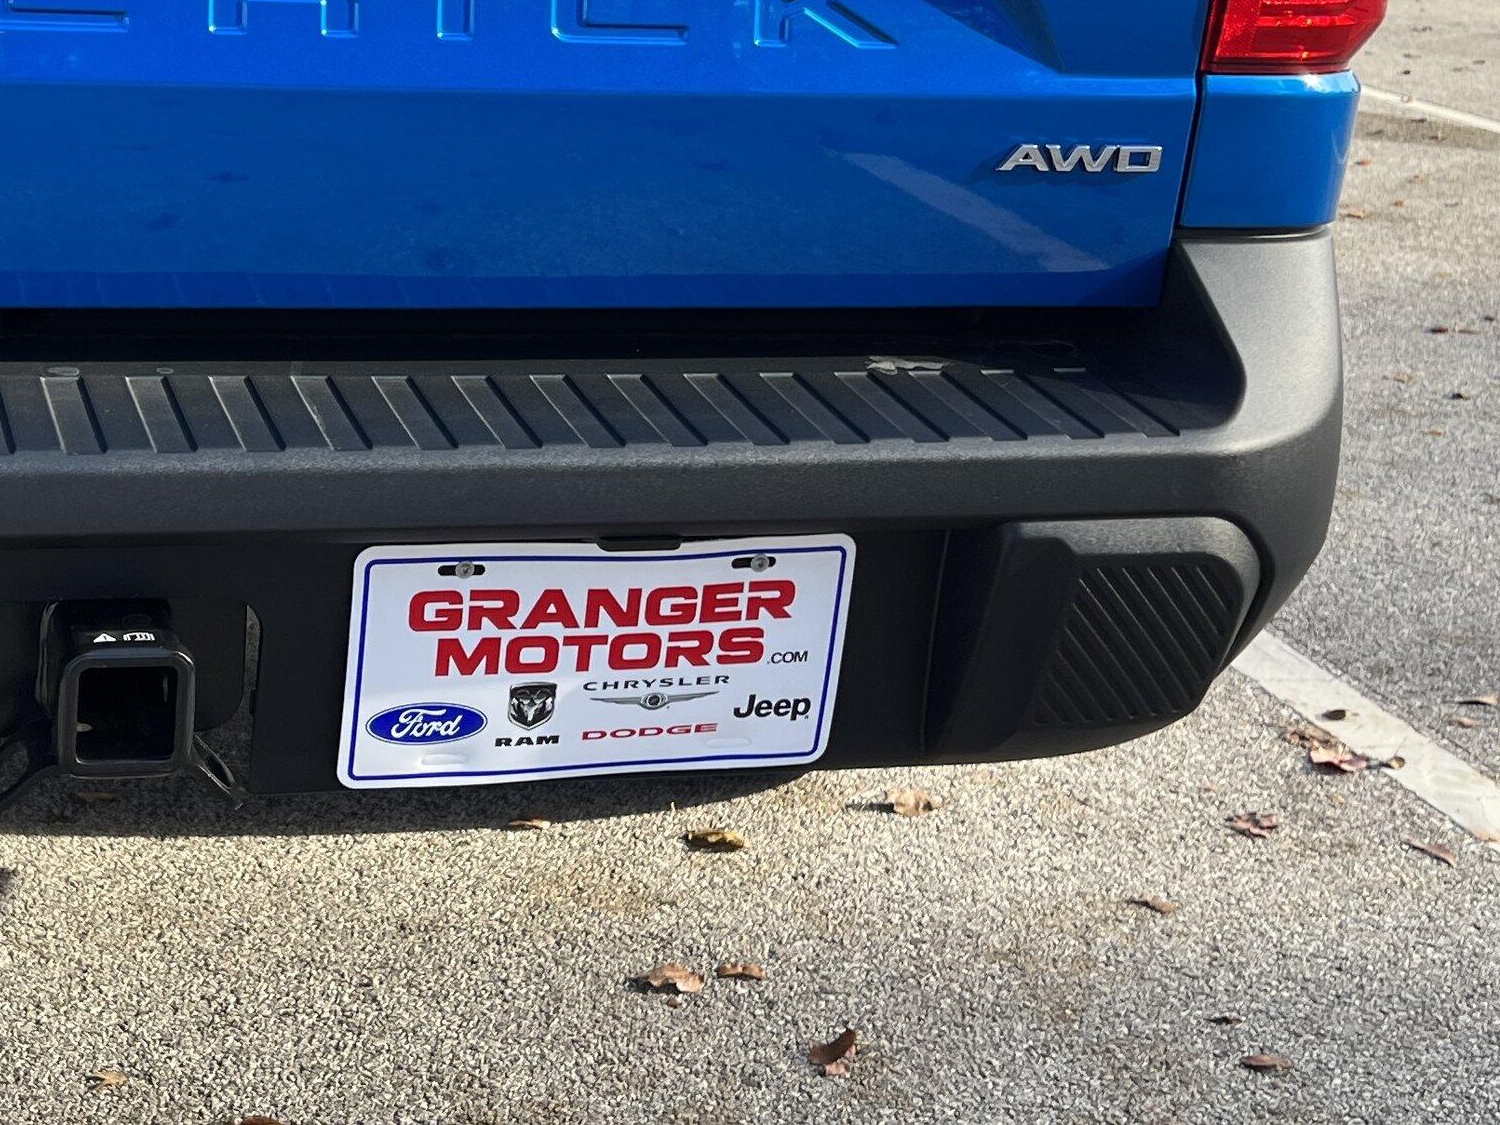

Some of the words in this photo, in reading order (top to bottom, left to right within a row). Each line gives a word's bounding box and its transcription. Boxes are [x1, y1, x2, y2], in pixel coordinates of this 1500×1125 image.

[995, 144, 1163, 173] AWD
[408, 579, 797, 633] GRANGER
[434, 626, 765, 677] MOTORS
[766, 650, 809, 666] .COM
[582, 675, 730, 692] CHRYSLER
[732, 693, 812, 722] Jeep
[390, 707, 463, 739] Ford
[581, 722, 719, 741] DODGE
[494, 734, 561, 748] RAM
